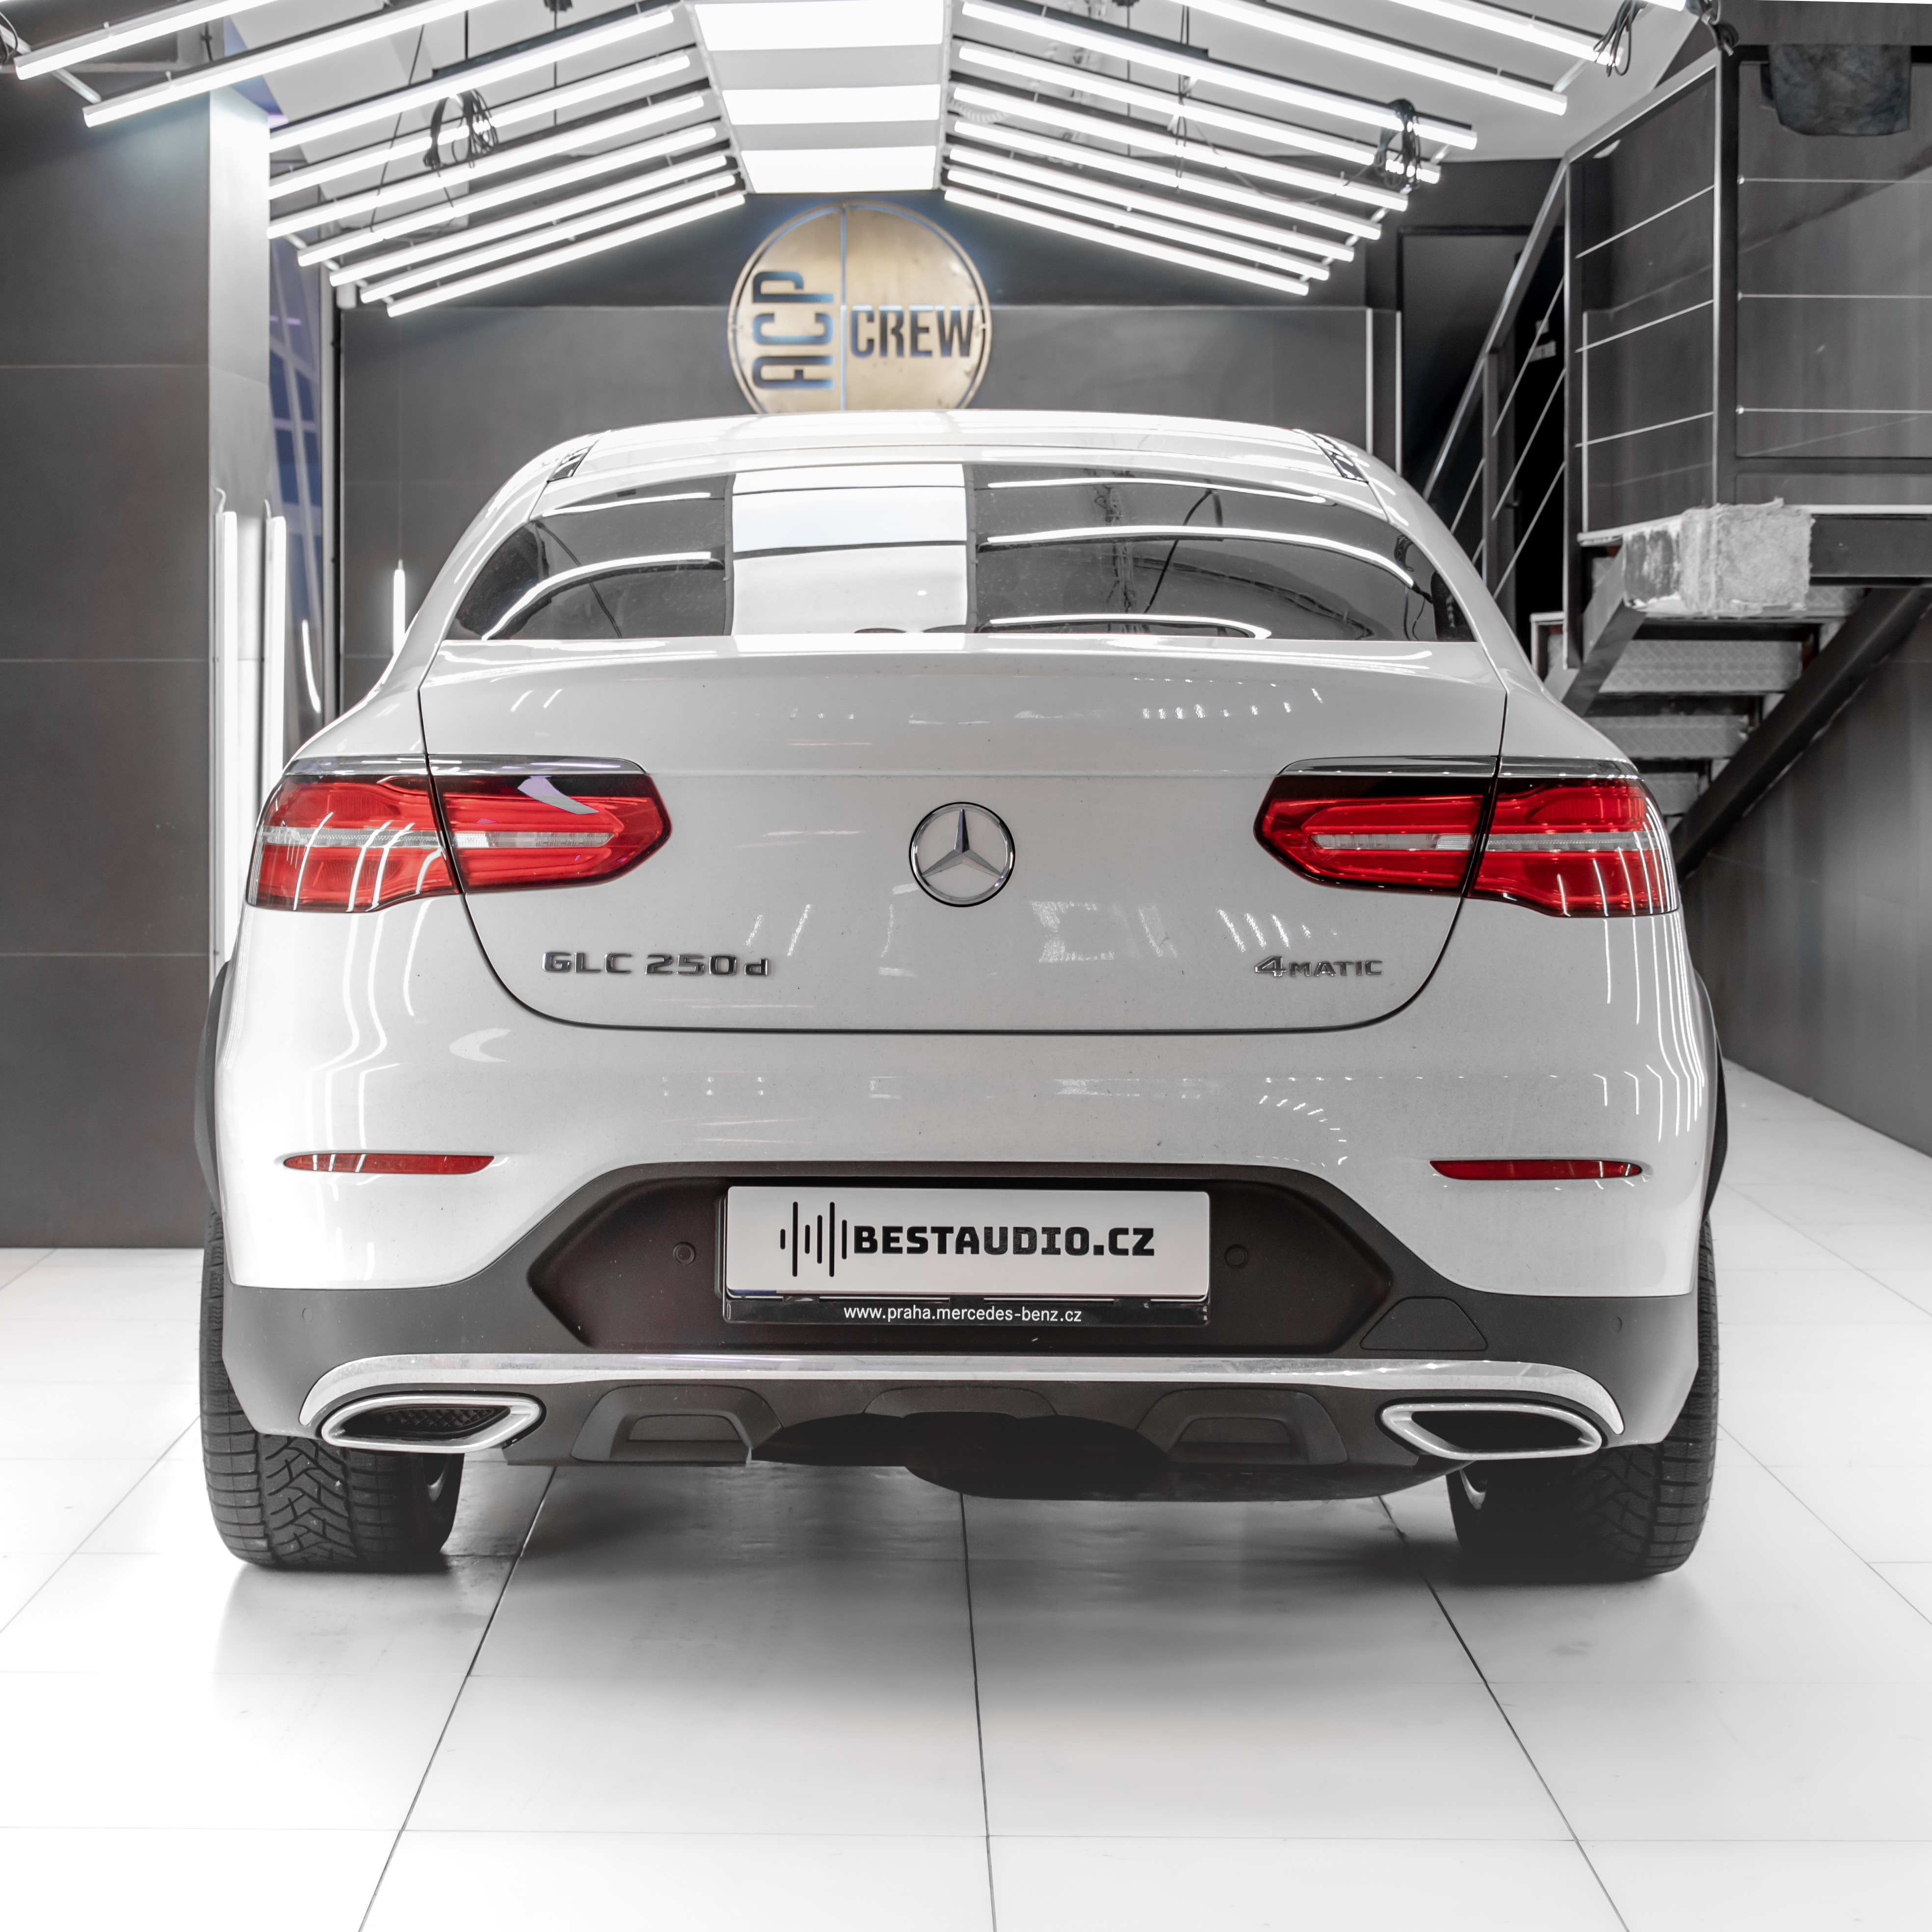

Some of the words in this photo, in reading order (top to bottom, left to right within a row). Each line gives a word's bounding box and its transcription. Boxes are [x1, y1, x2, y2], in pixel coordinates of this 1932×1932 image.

[851, 305, 975, 357] CREW
[542, 951, 632, 974] GLC
[1254, 955, 1383, 978] 4MATIC
[853, 1225, 1155, 1256] BESTAUDIO.CZ
[843, 1305, 1083, 1323] www.praha.mercedes-benz.cz
